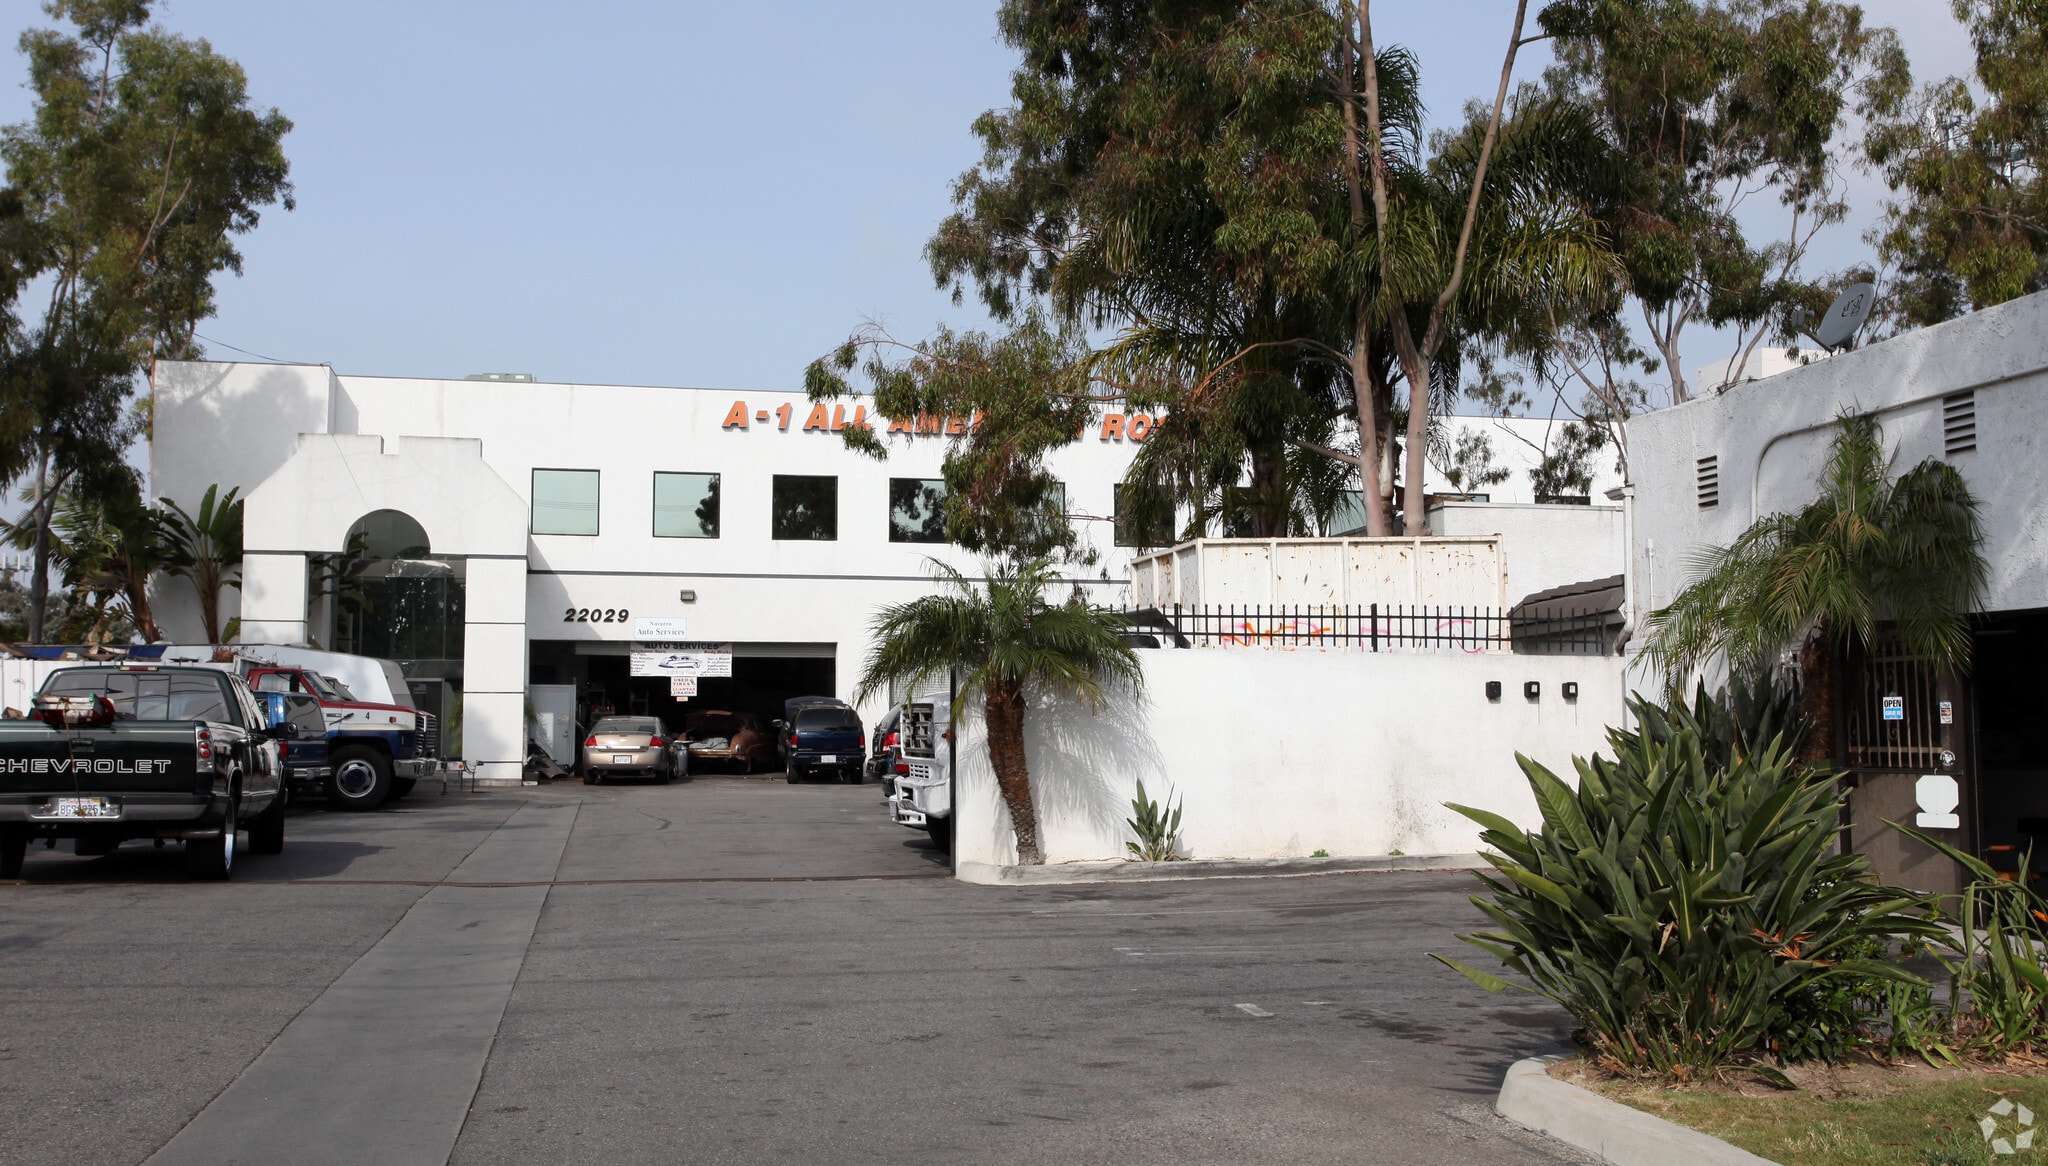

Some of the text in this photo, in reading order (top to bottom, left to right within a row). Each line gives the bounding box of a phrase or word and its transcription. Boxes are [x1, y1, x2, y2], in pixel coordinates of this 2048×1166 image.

[721, 400, 792, 431] A-1
[802, 403, 873, 432] ALL
[563, 608, 630, 623] 22029
[637, 628, 685, 636] Auto Services
[644, 642, 719, 650] AUTO SERVICES
[1884, 699, 1902, 708] OPEN
[365, 711, 371, 720] 4
